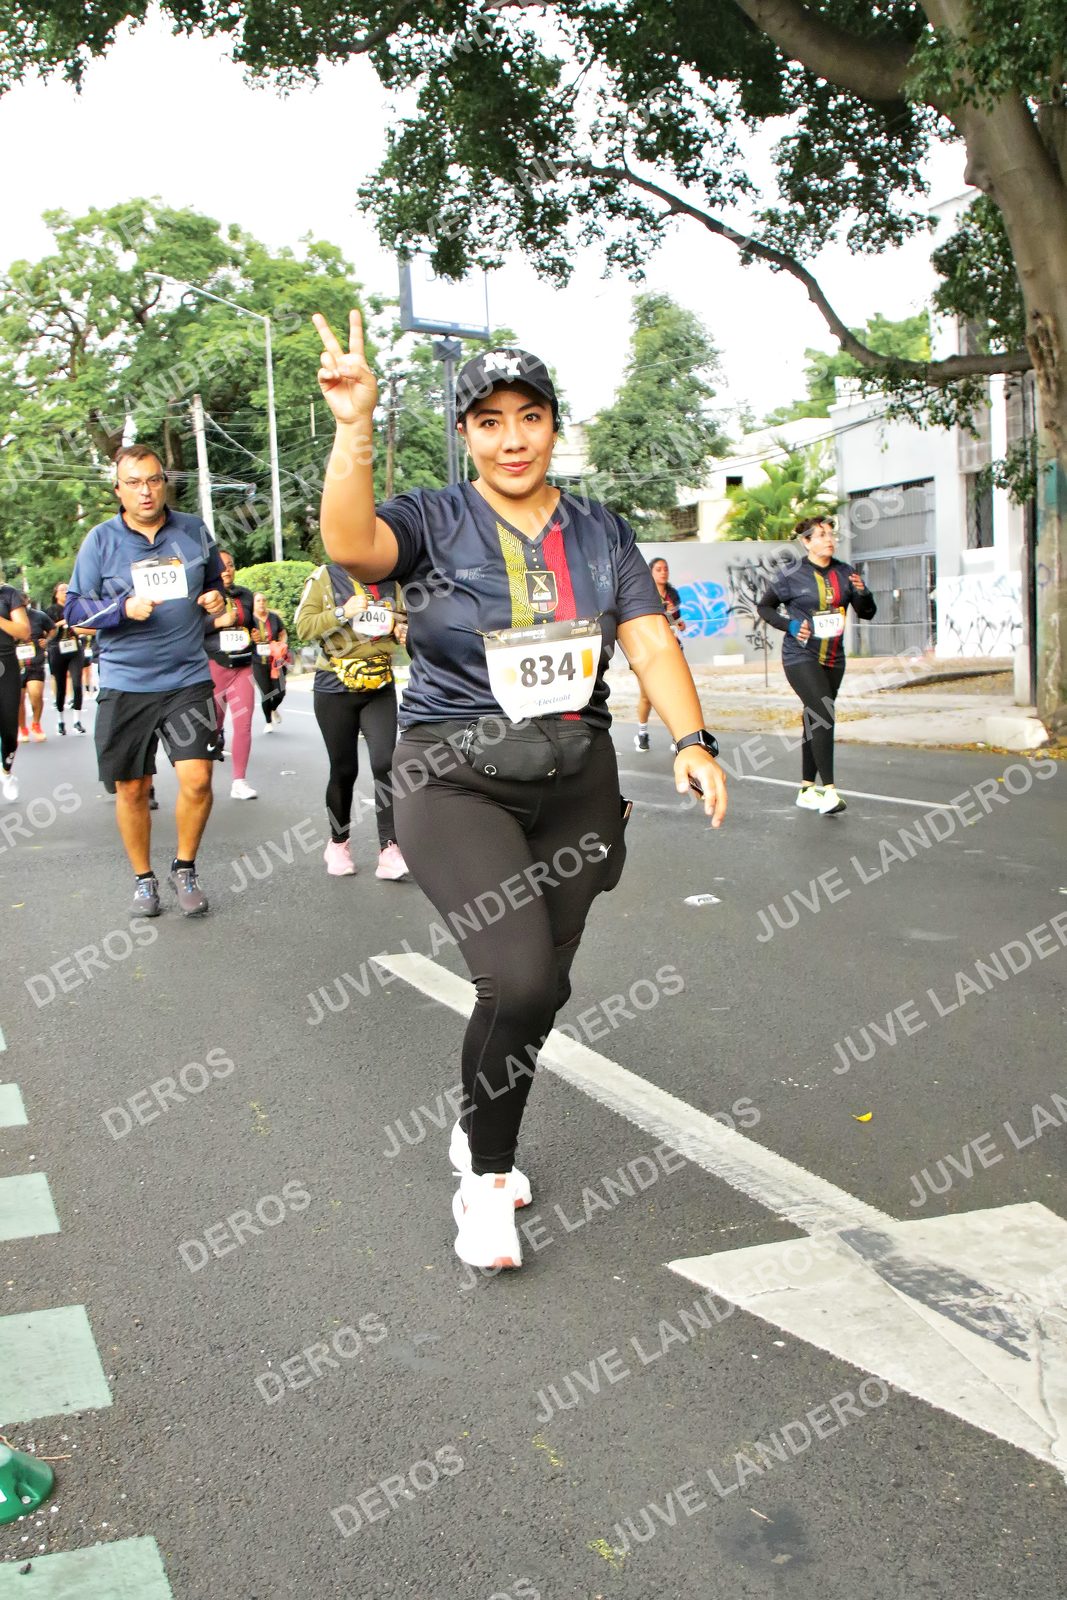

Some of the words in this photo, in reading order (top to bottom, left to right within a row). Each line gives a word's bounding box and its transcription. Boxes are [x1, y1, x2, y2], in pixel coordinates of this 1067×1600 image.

[144, 570, 177, 587] 1059
[358, 611, 386, 623] 2040
[520, 652, 576, 688] 834
